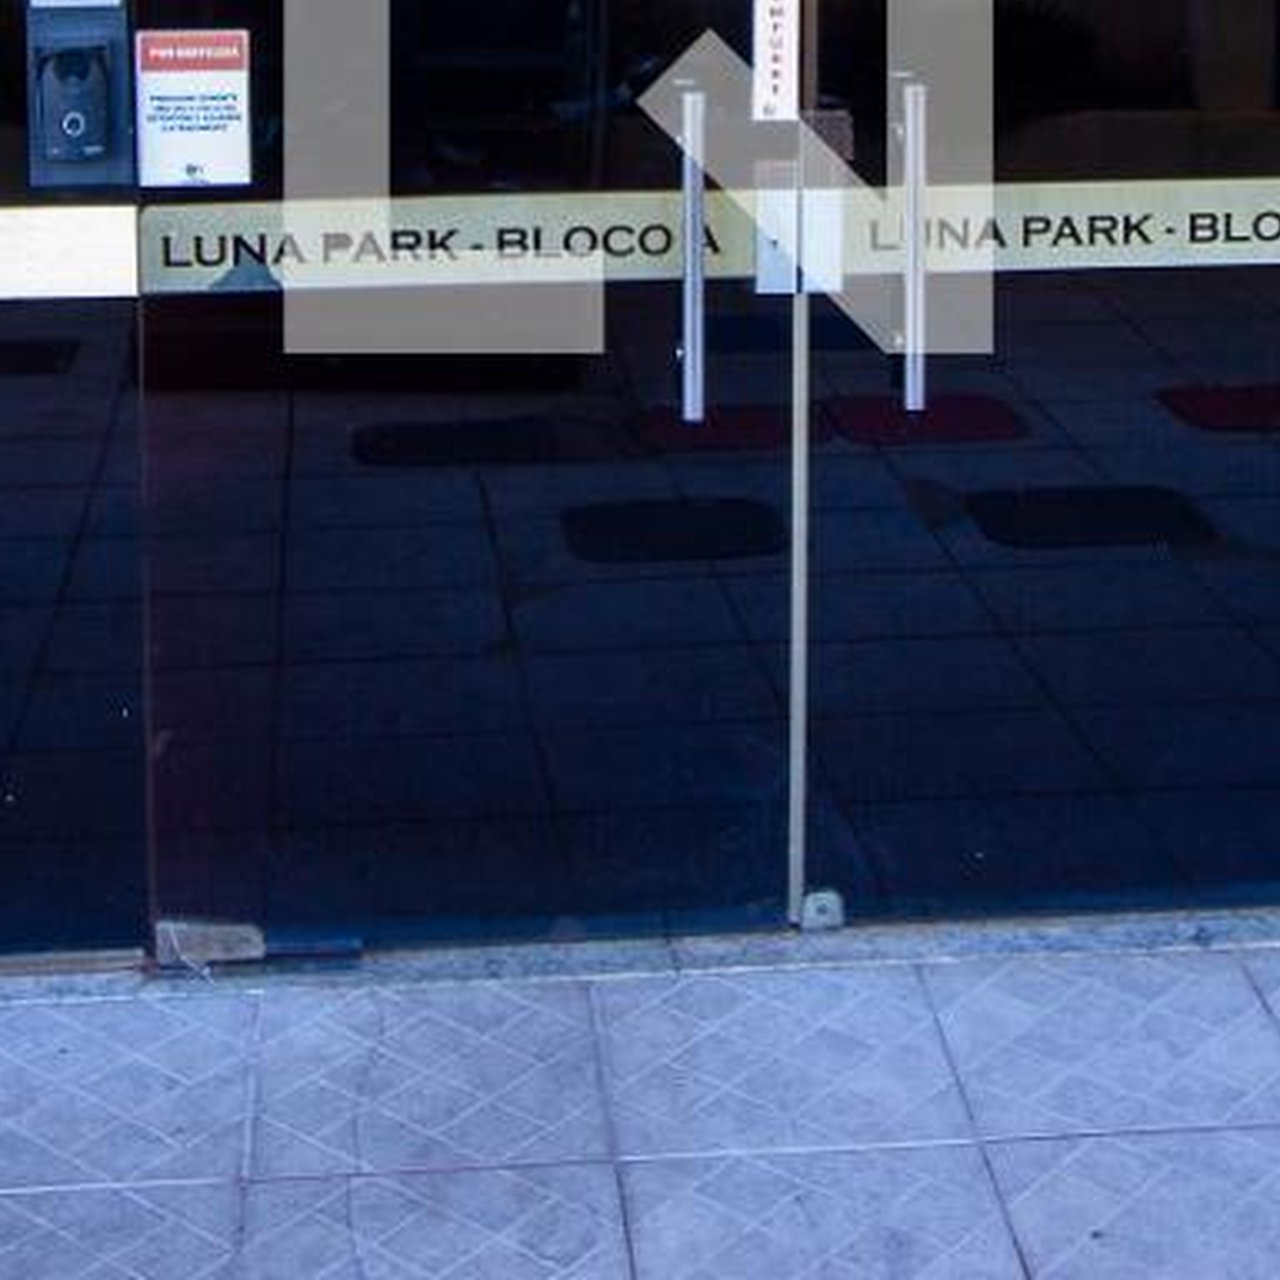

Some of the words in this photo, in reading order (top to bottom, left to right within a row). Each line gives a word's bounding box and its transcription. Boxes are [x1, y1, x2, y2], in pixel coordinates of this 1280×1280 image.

[163, 231, 306, 268] LUNA
[322, 227, 459, 263] PARK
[496, 224, 673, 259] BLOCO
[1023, 214, 1153, 247] PARK
